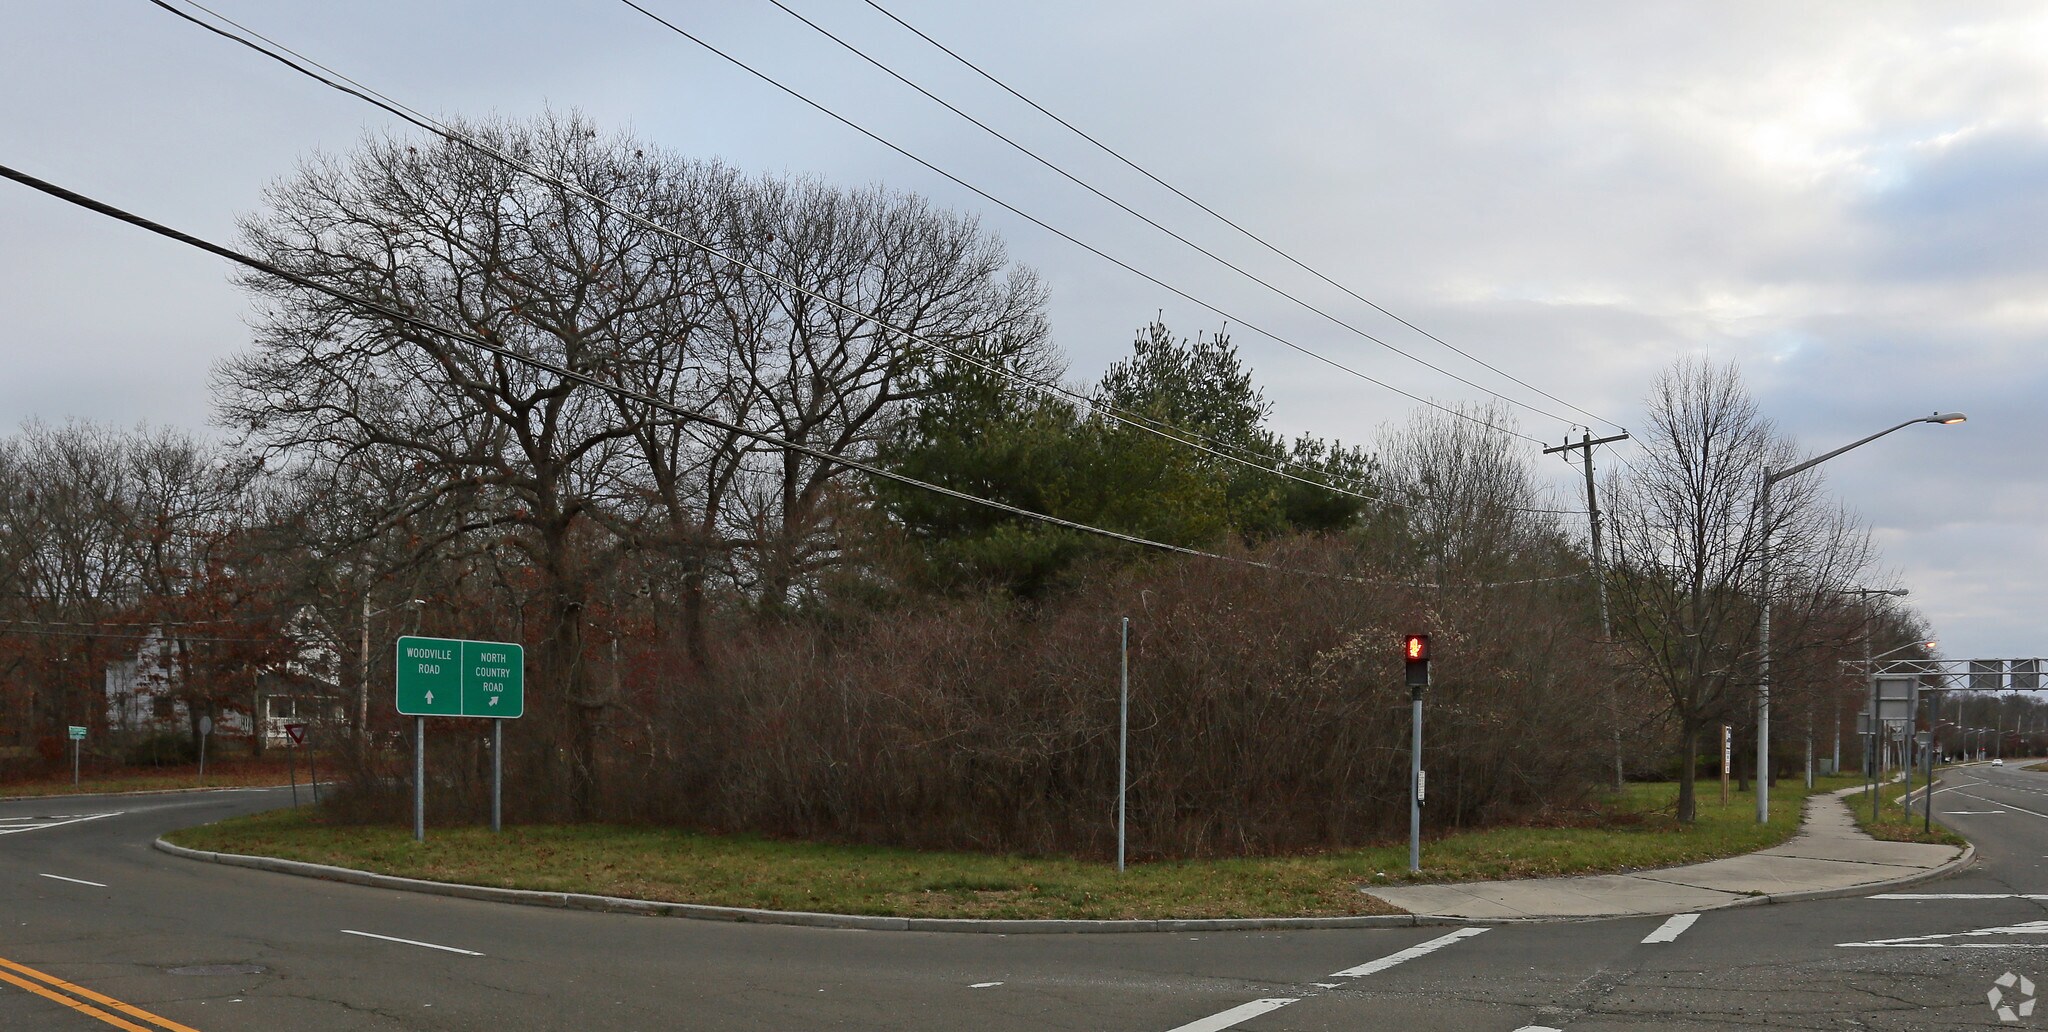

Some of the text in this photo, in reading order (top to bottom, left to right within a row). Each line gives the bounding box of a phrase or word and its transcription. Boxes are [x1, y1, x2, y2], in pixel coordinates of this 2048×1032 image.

[407, 647, 451, 660] WOODVILLE
[481, 652, 506, 663] NORTH
[418, 663, 440, 675] ROAD
[475, 667, 510, 678] COUNTRY
[483, 682, 503, 692] ROAD
